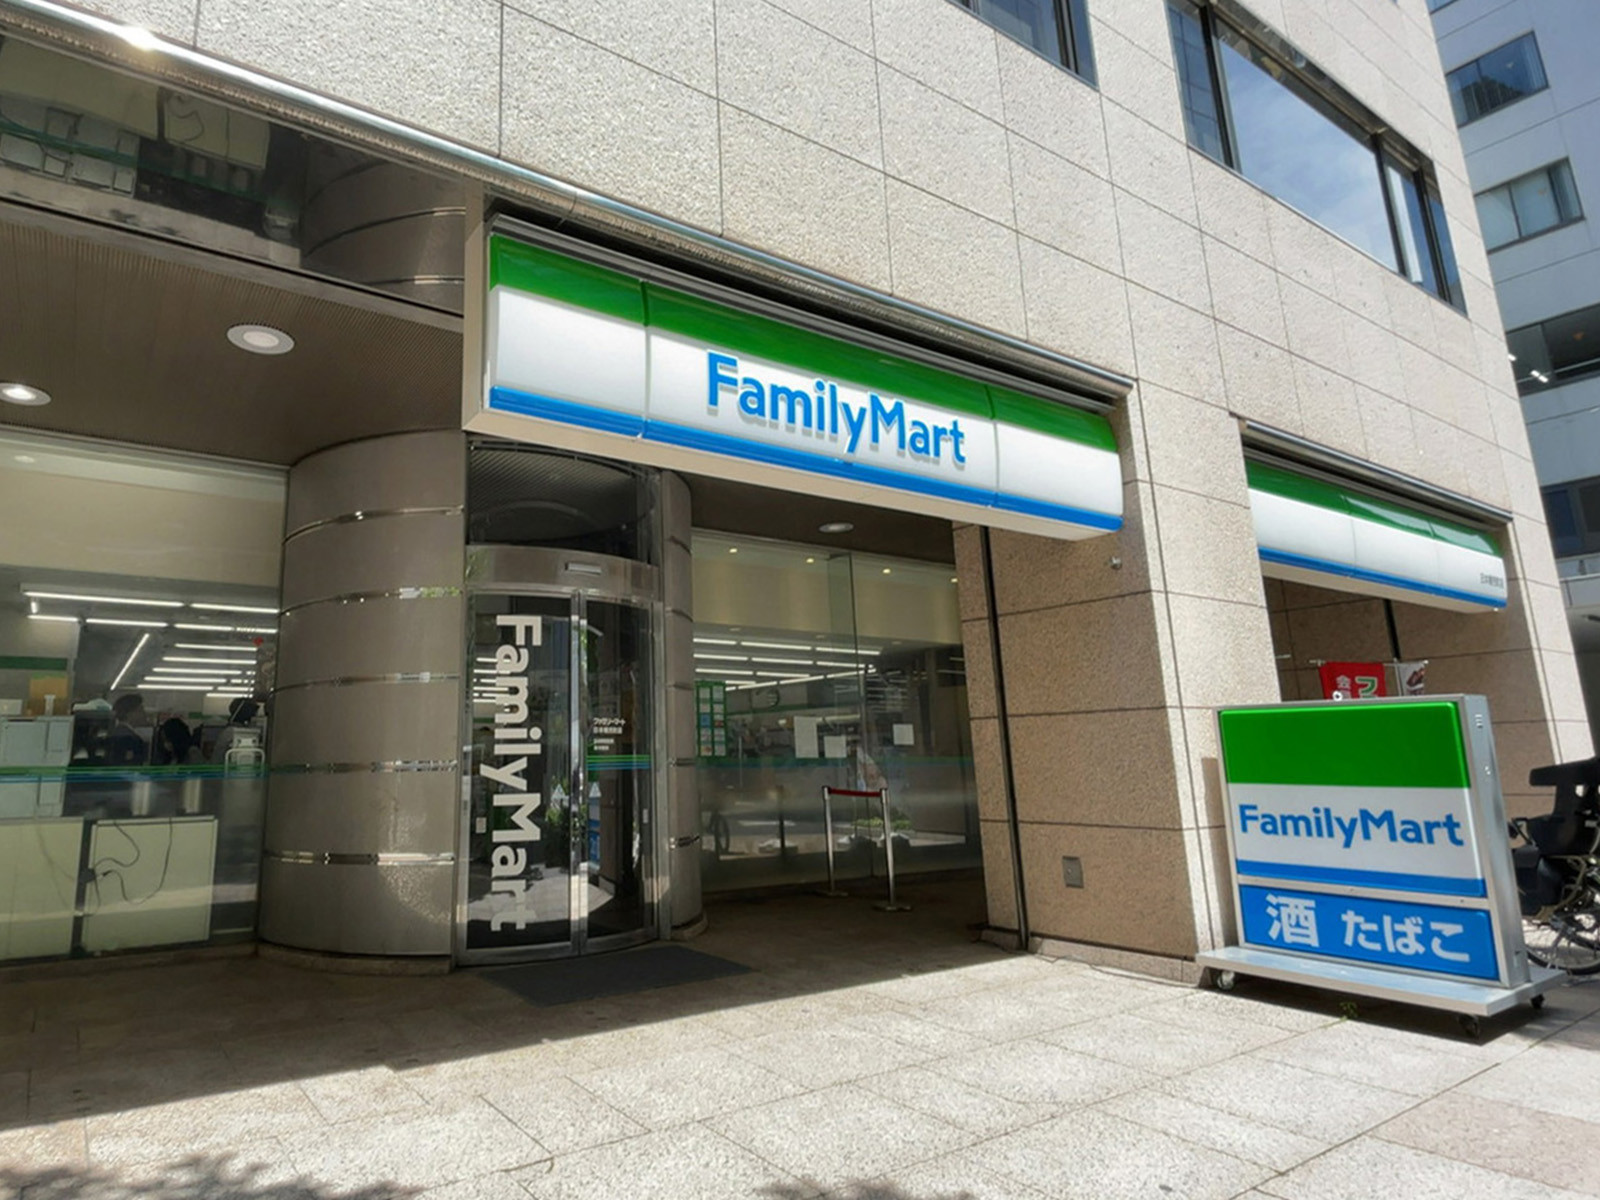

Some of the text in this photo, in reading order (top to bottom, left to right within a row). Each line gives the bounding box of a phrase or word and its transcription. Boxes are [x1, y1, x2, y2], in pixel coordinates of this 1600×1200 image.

[707, 350, 966, 465] FamilyMart
[479, 615, 543, 931] FamilyMart
[1239, 804, 1464, 848] FamilyMart
[1265, 893, 1471, 963] 酒 たばこ
